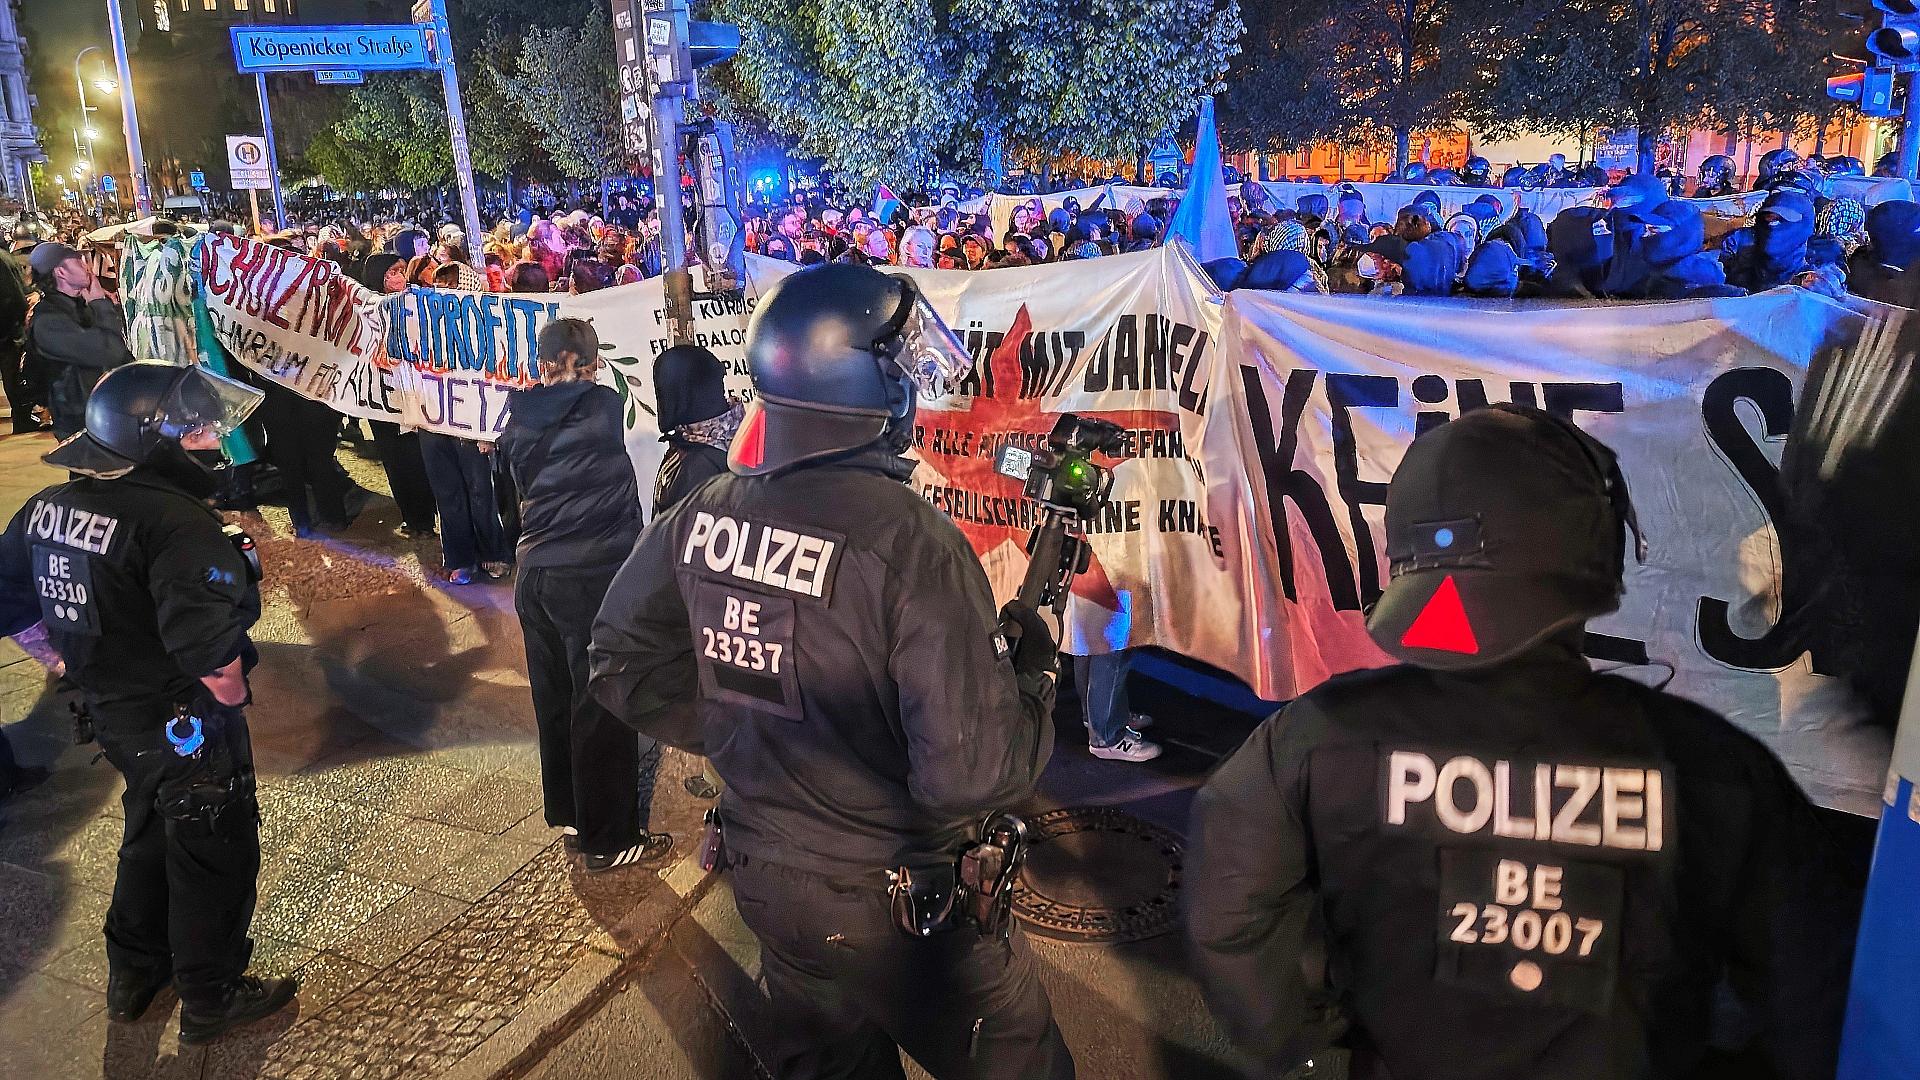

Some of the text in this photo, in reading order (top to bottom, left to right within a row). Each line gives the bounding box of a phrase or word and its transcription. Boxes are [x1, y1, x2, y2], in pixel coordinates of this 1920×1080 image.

[250, 35, 413, 61] Köpenicker Straße
[242, 147, 255, 160] H
[341, 362, 402, 414] ALLE
[1020, 331, 1085, 398] MIT
[27, 500, 118, 555] POLIZEI
[1066, 500, 1141, 536] HNE
[48, 554, 71, 579] BE
[684, 511, 835, 598] POLIZEI
[38, 576, 88, 605] 23310
[723, 595, 763, 636] BE
[702, 627, 783, 674] 23237
[1387, 750, 1663, 851] POLIZEI
[1495, 858, 1563, 911] BE
[1450, 902, 1603, 957] 23007
